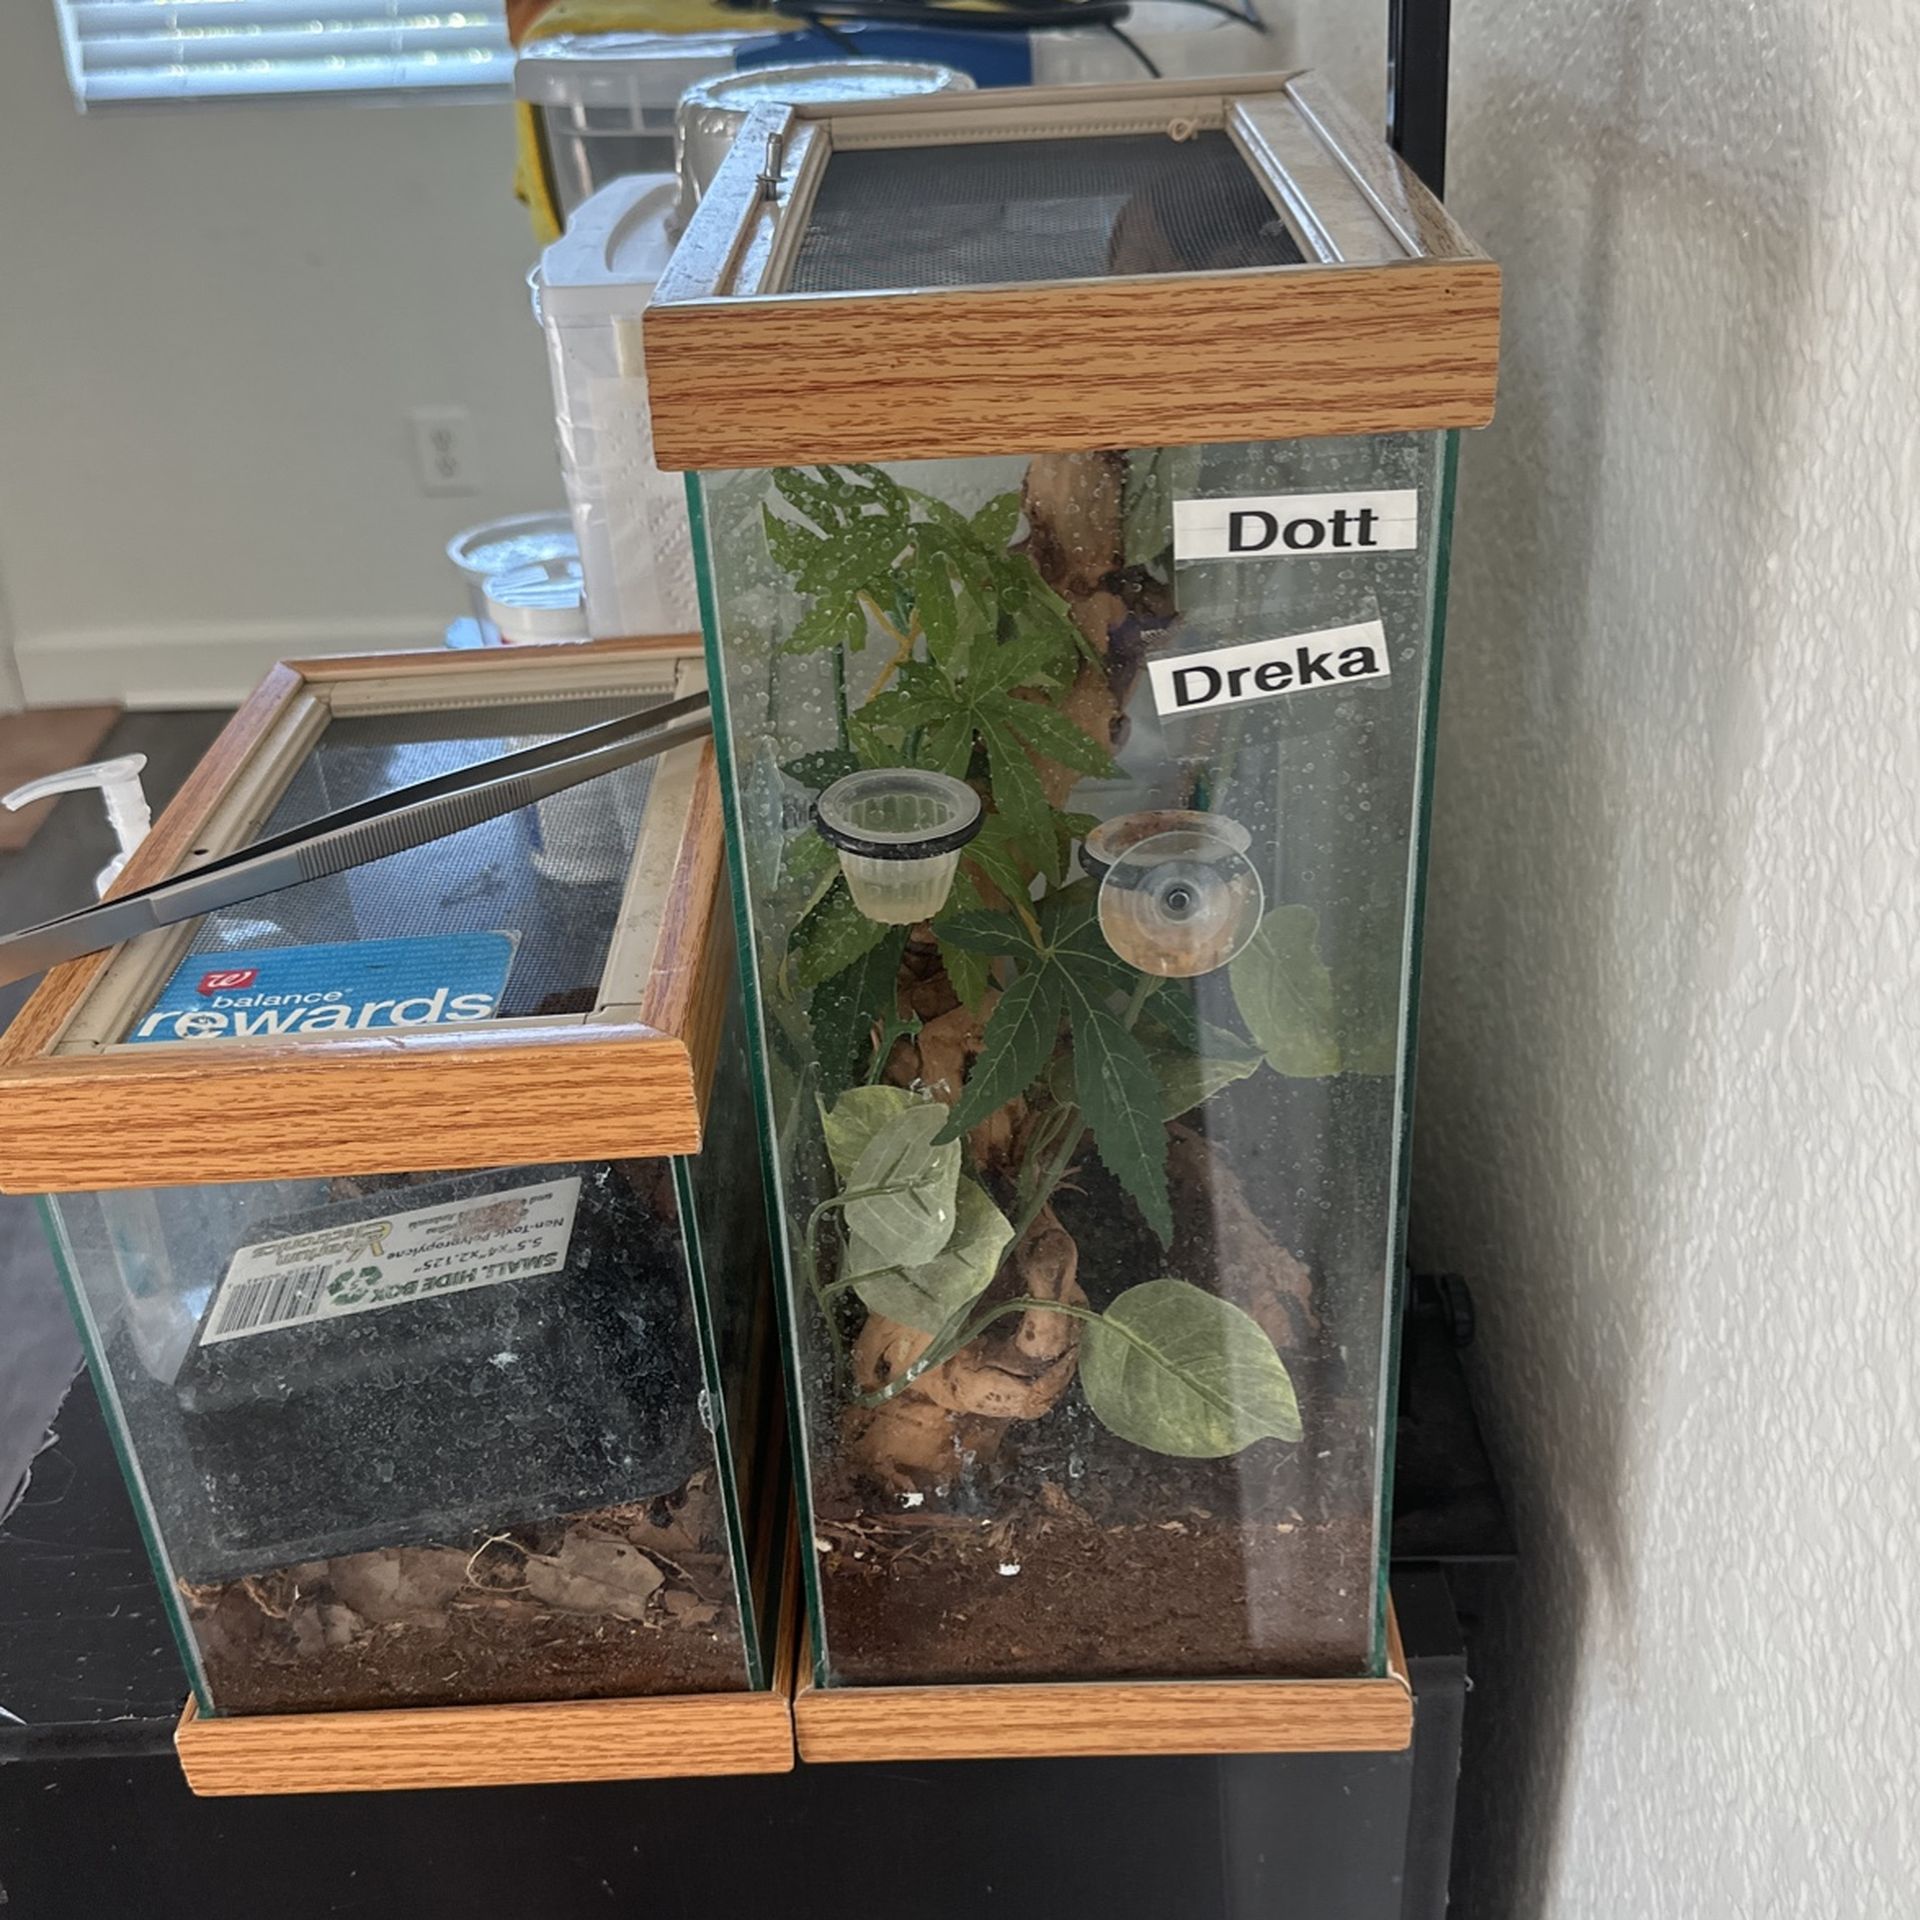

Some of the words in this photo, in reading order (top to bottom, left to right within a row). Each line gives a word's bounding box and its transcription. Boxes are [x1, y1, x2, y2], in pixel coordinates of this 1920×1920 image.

[1229, 508, 1379, 552] Dott
[1172, 645, 1380, 707] Dreka
[137, 987, 494, 1039] rewards
[211, 991, 343, 1009] balance
[493, 1217, 564, 1240] Non-Toxic
[482, 1251, 558, 1278] SMALL
[369, 1280, 419, 1304] BOX
[421, 1266, 477, 1292] HIDE
